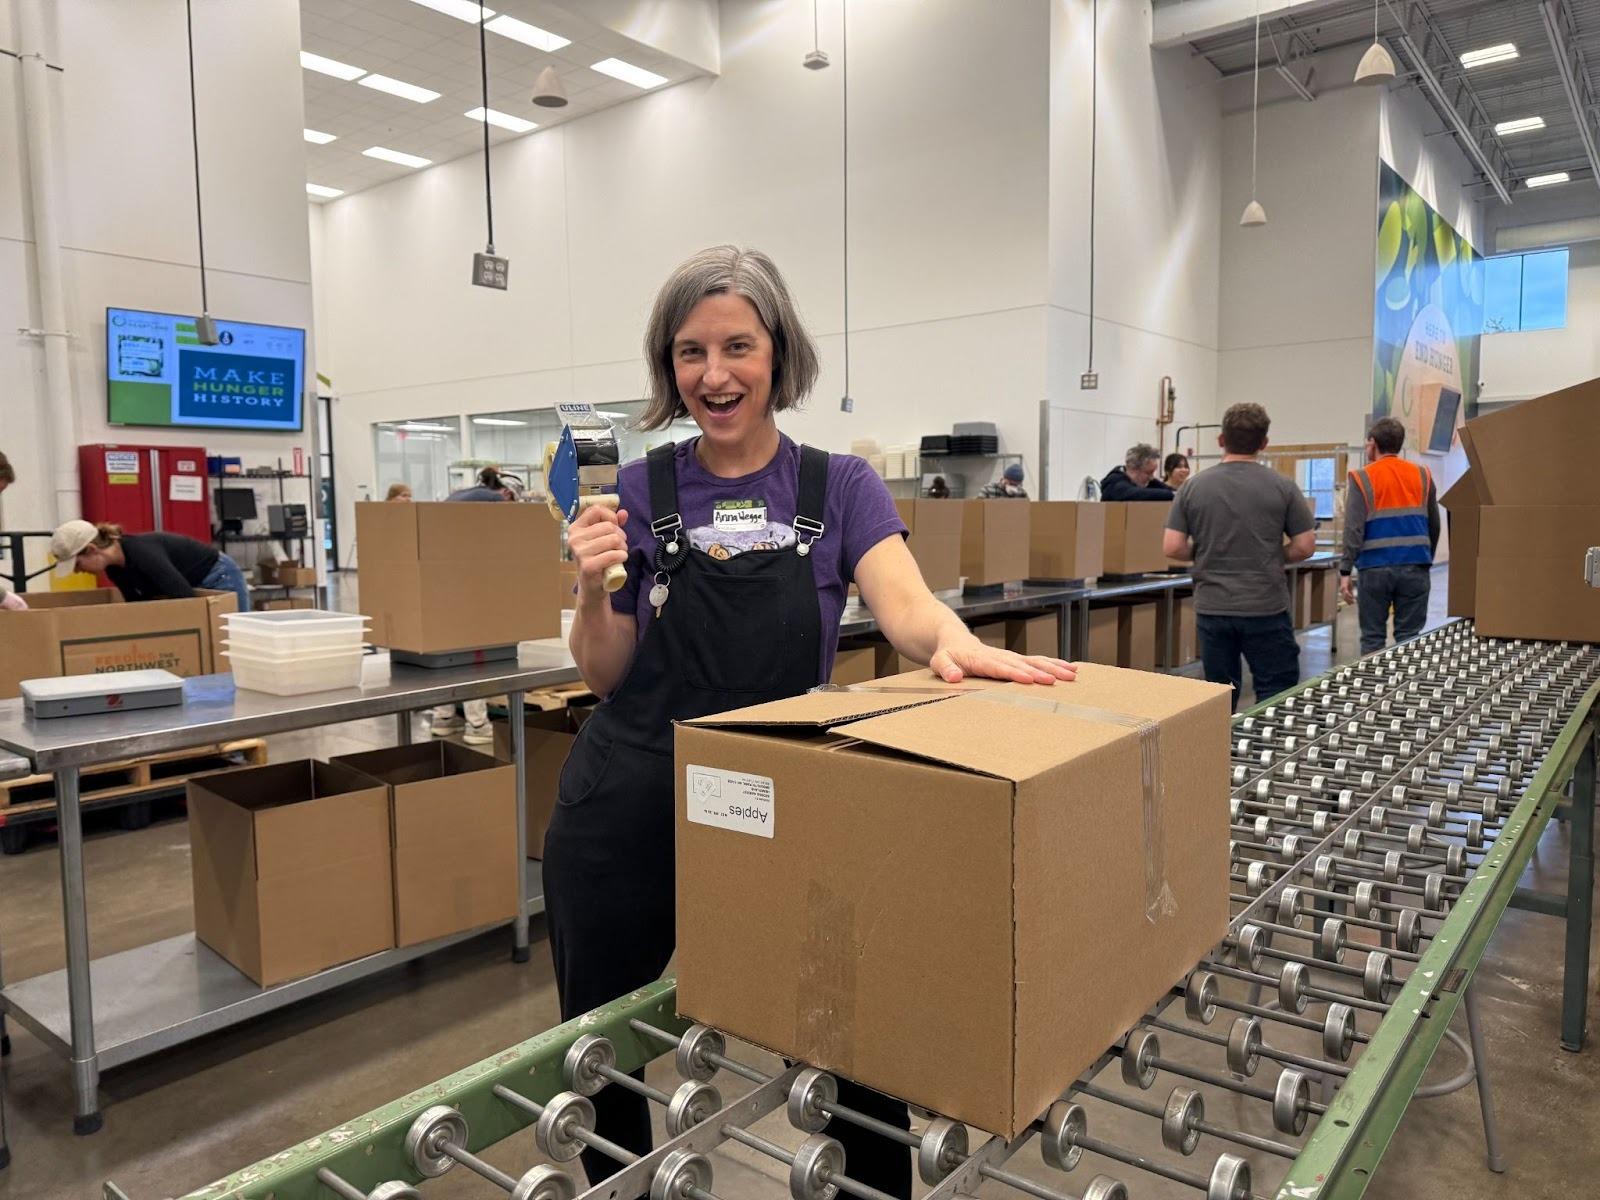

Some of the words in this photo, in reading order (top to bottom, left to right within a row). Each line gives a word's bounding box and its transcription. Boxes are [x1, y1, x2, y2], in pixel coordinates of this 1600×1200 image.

[194, 366, 284, 385] MAKE
[193, 382, 284, 396] HUNGER
[194, 394, 284, 407] HISTORY
[561, 404, 590, 412] ULINE
[715, 511, 738, 523] Anna
[95, 658, 180, 673] NORTHWEST
[729, 805, 768, 823] Apples
